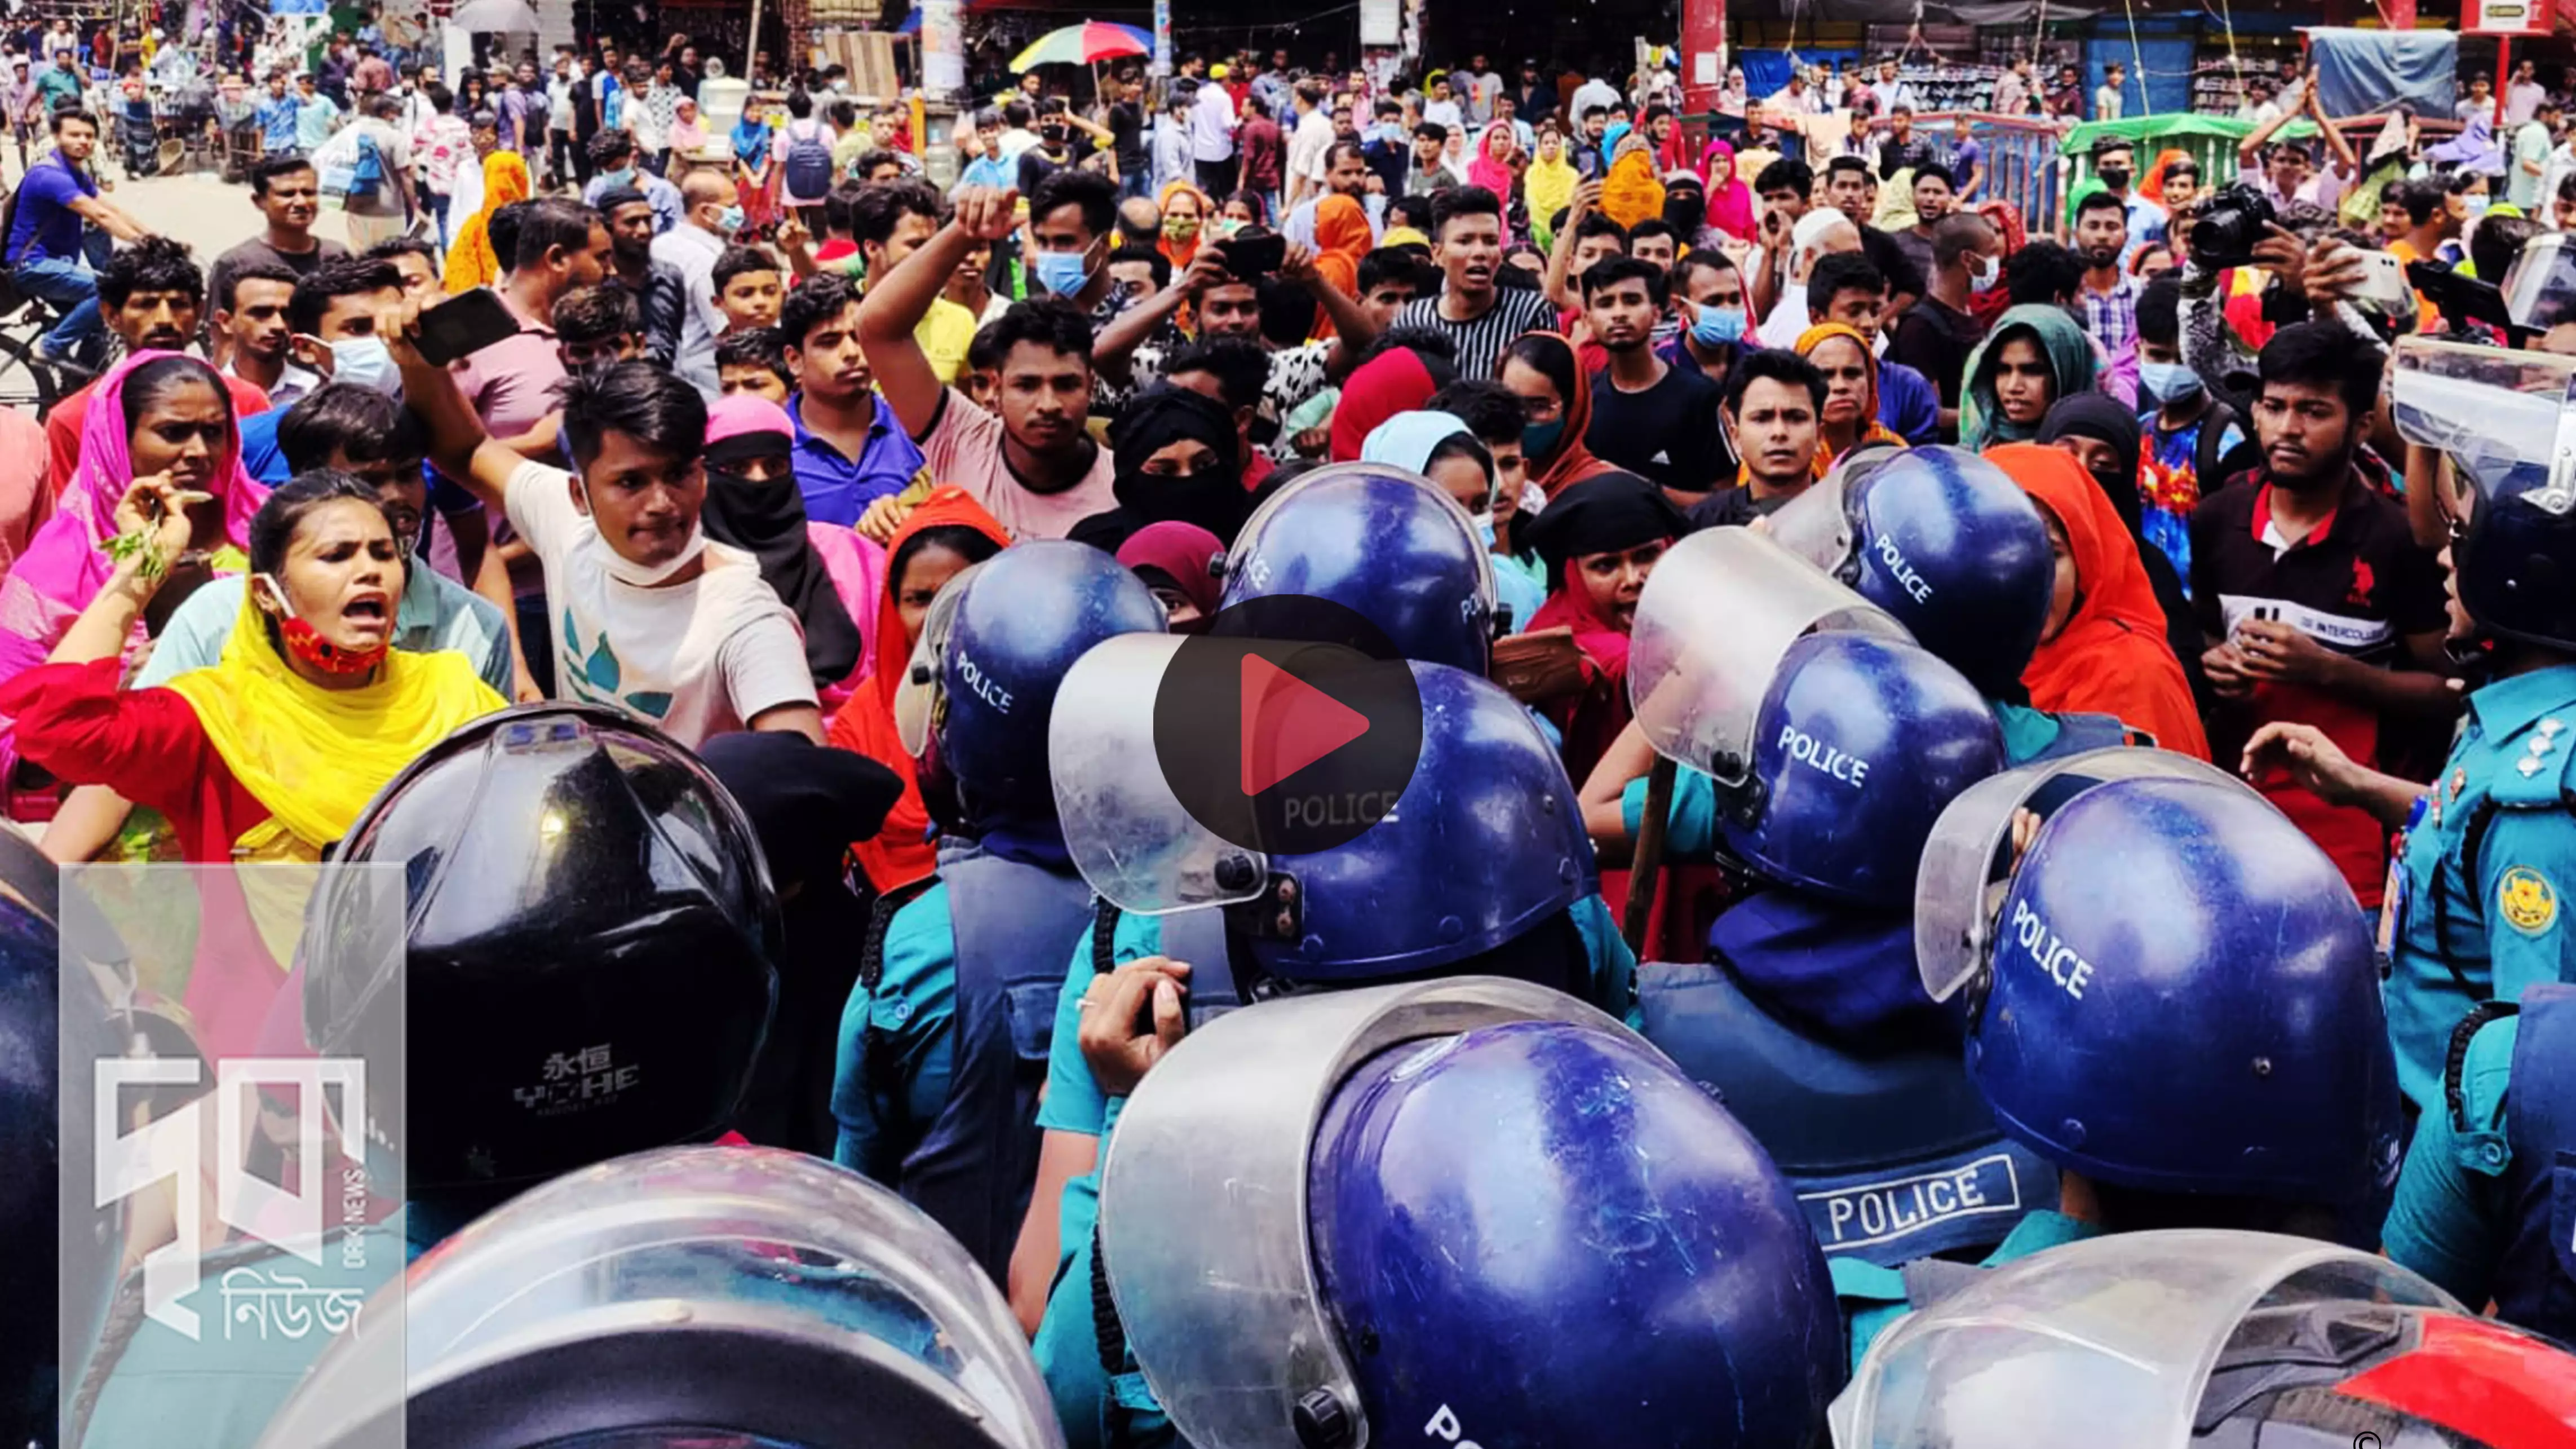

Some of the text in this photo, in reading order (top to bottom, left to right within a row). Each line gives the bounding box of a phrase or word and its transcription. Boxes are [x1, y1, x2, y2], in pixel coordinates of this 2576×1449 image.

[1875, 533, 1933, 605] POLICE
[956, 650, 1013, 714] POLICE
[1777, 724, 1870, 788] POLICE
[1285, 792, 1400, 829] POLICE
[2012, 898, 2094, 1000] POLICE
[1829, 1169, 1986, 1241] POLICE
